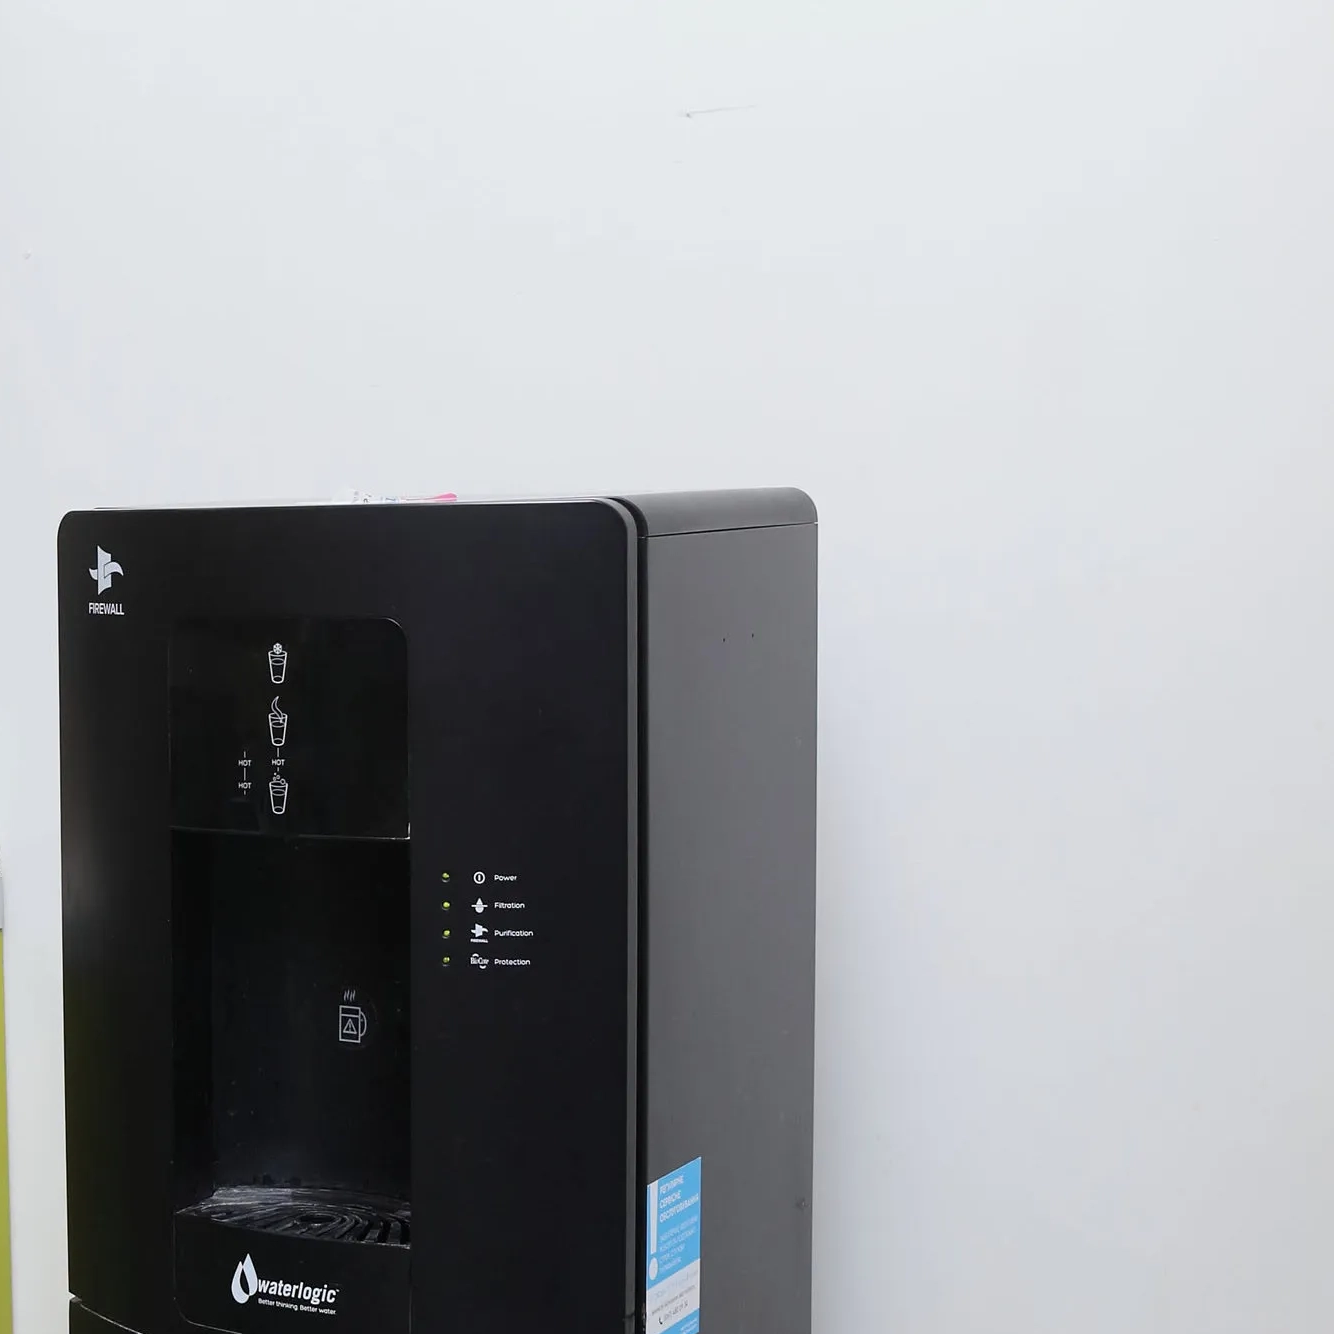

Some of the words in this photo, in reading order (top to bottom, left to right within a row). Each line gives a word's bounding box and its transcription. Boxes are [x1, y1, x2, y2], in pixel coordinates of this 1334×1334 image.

[88, 602, 125, 615] FIREWALL
[238, 759, 252, 767] HOT
[271, 758, 286, 766] HOT
[494, 958, 531, 966] Protection
[258, 1279, 337, 1305] waterlogic
[258, 1298, 275, 1306] Better
[299, 1304, 318, 1313] Better
